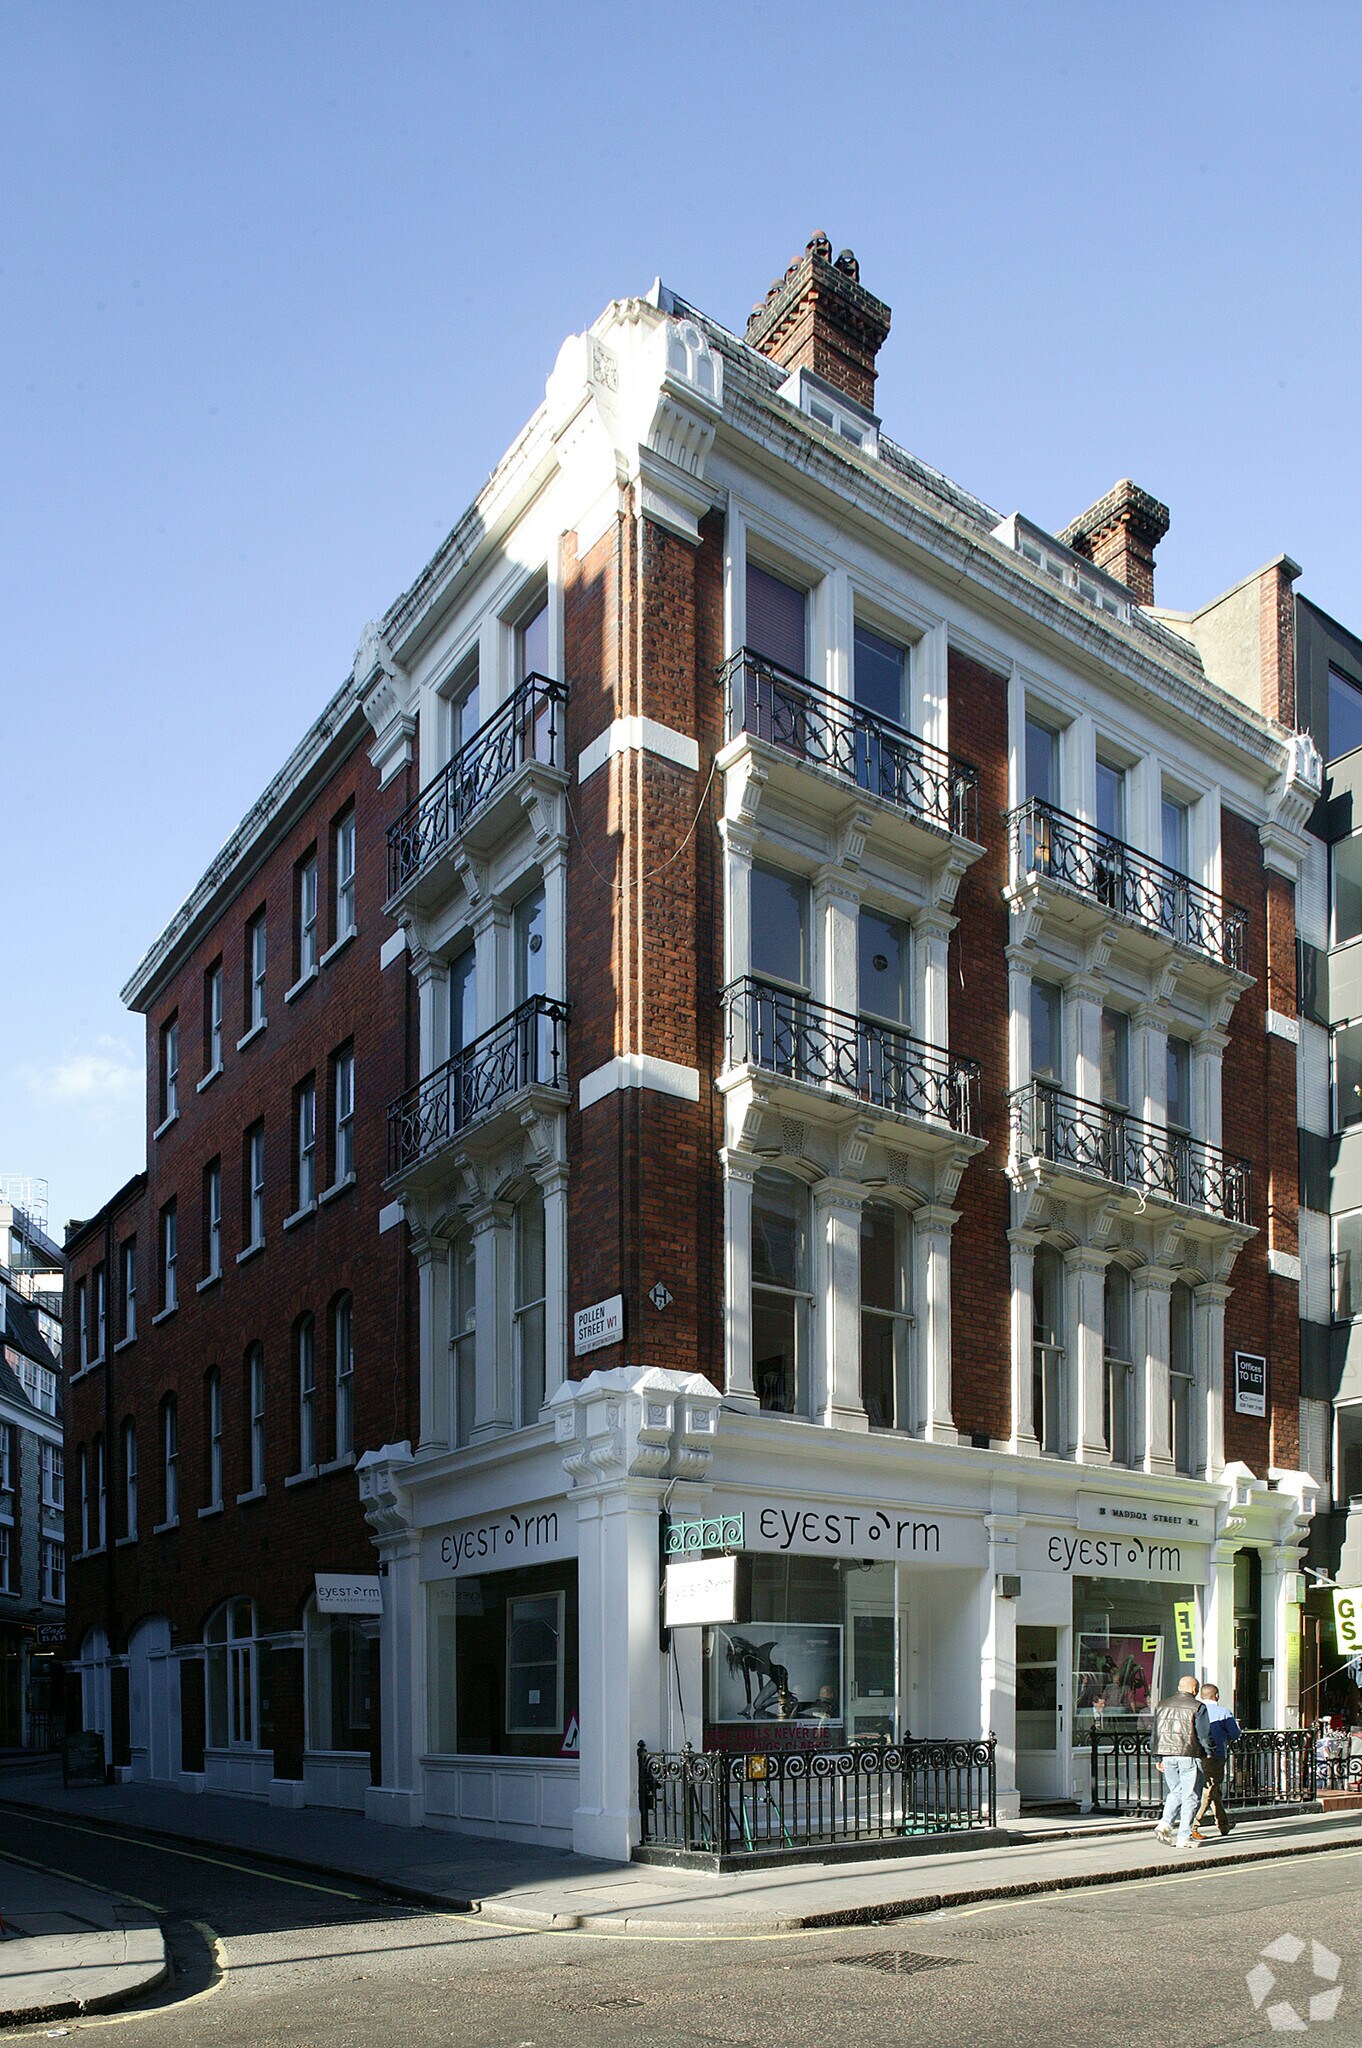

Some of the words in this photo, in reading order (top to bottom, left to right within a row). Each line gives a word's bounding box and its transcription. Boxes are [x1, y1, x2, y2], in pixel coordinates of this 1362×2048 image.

[578, 1306, 605, 1327] POLLEN
[578, 1319, 605, 1341] STREET
[606, 1315, 617, 1330] W1
[1240, 1361, 1262, 1373] Offices
[1239, 1371, 1249, 1380] TO
[1250, 1373, 1263, 1383] LET
[1112, 1509, 1148, 1521] MADDOX
[1153, 1514, 1183, 1525] STREET
[774, 1726, 810, 1739] NEVER
